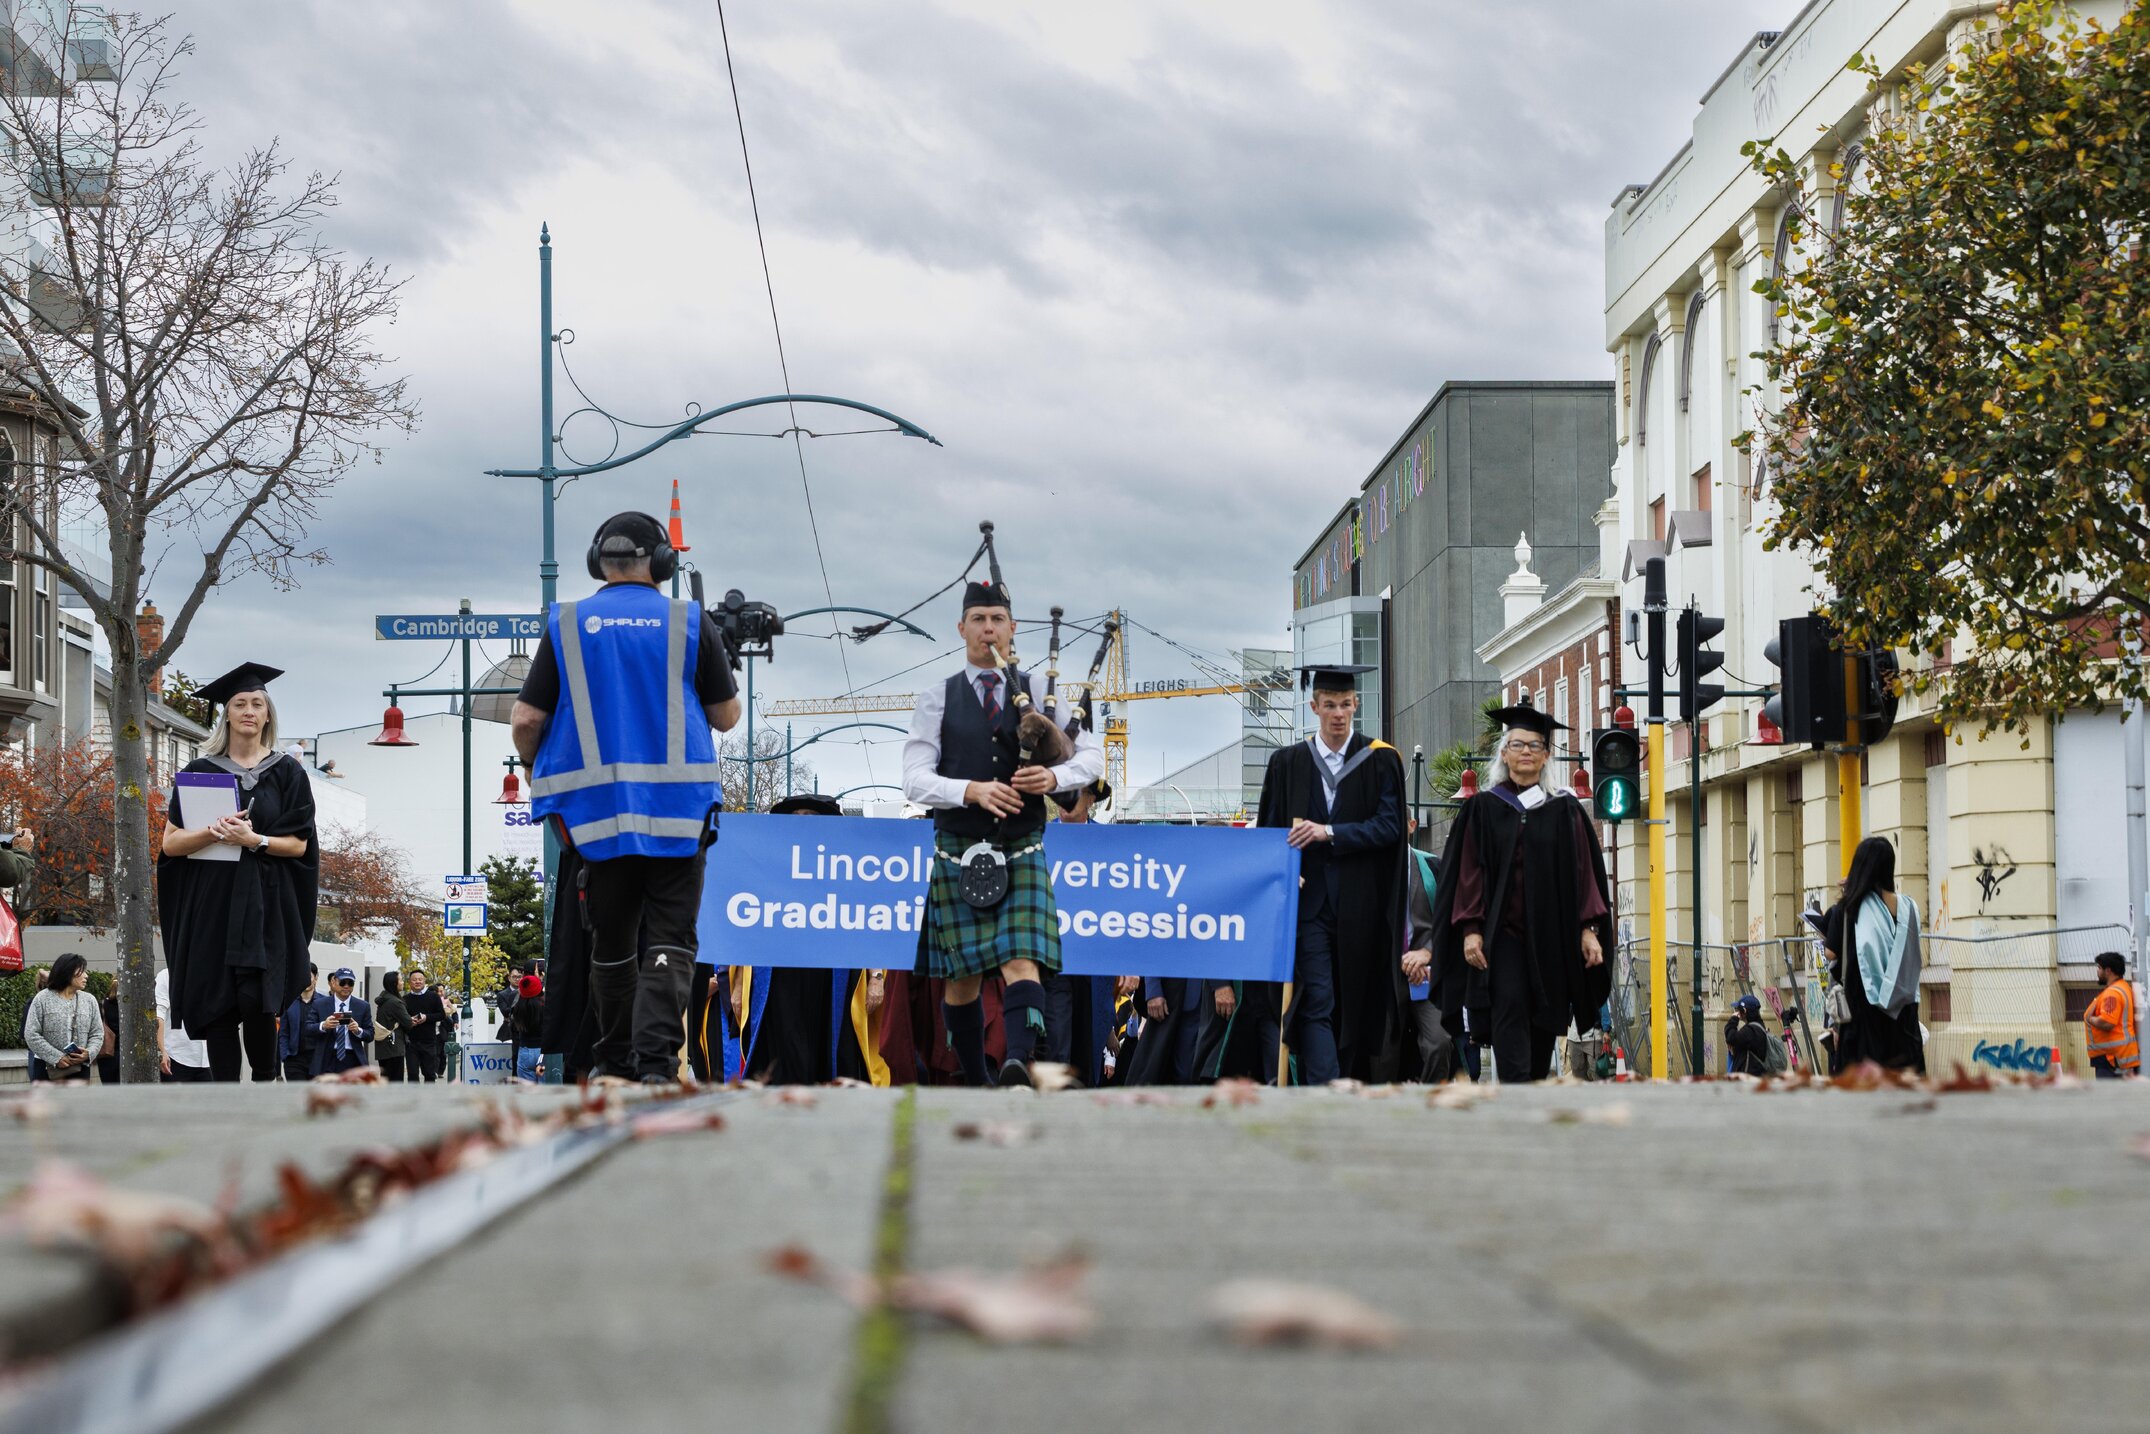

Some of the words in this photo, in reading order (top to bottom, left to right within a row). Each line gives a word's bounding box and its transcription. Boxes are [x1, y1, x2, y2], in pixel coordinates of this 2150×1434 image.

[1395, 426, 1436, 518] ALRIGHT
[393, 618, 499, 638] Cambridge
[508, 618, 541, 634] Tce
[603, 618, 661, 627] SHIPLEYS
[1135, 679, 1185, 693] LEIGHS
[1051, 853, 1187, 898] versity
[727, 892, 925, 932] Graduati
[1056, 903, 1245, 941] ocession
